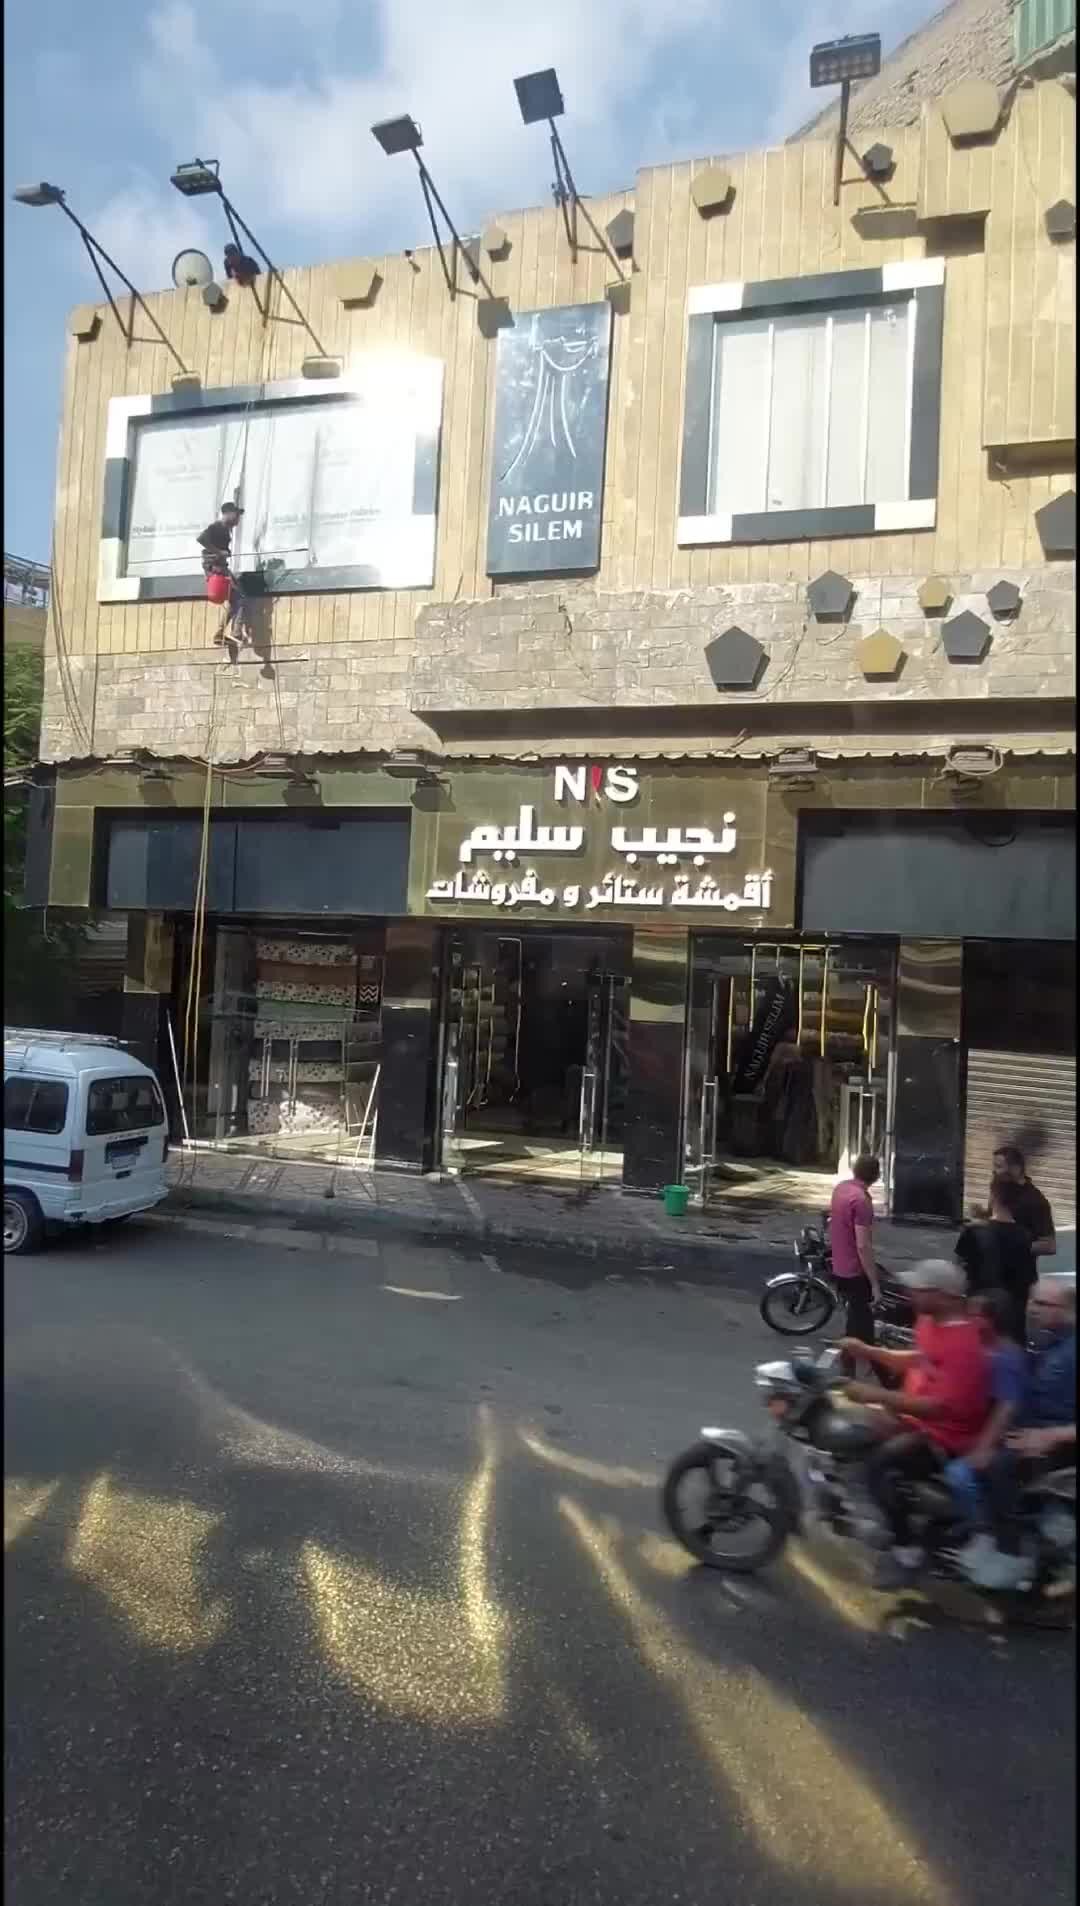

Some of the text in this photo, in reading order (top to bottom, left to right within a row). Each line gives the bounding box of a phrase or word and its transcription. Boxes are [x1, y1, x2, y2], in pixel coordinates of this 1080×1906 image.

[508, 519, 583, 543] SILEM
[459, 804, 737, 866] نجيب سليم
[425, 868, 774, 911] أقمشة ستائر و مفروشات
